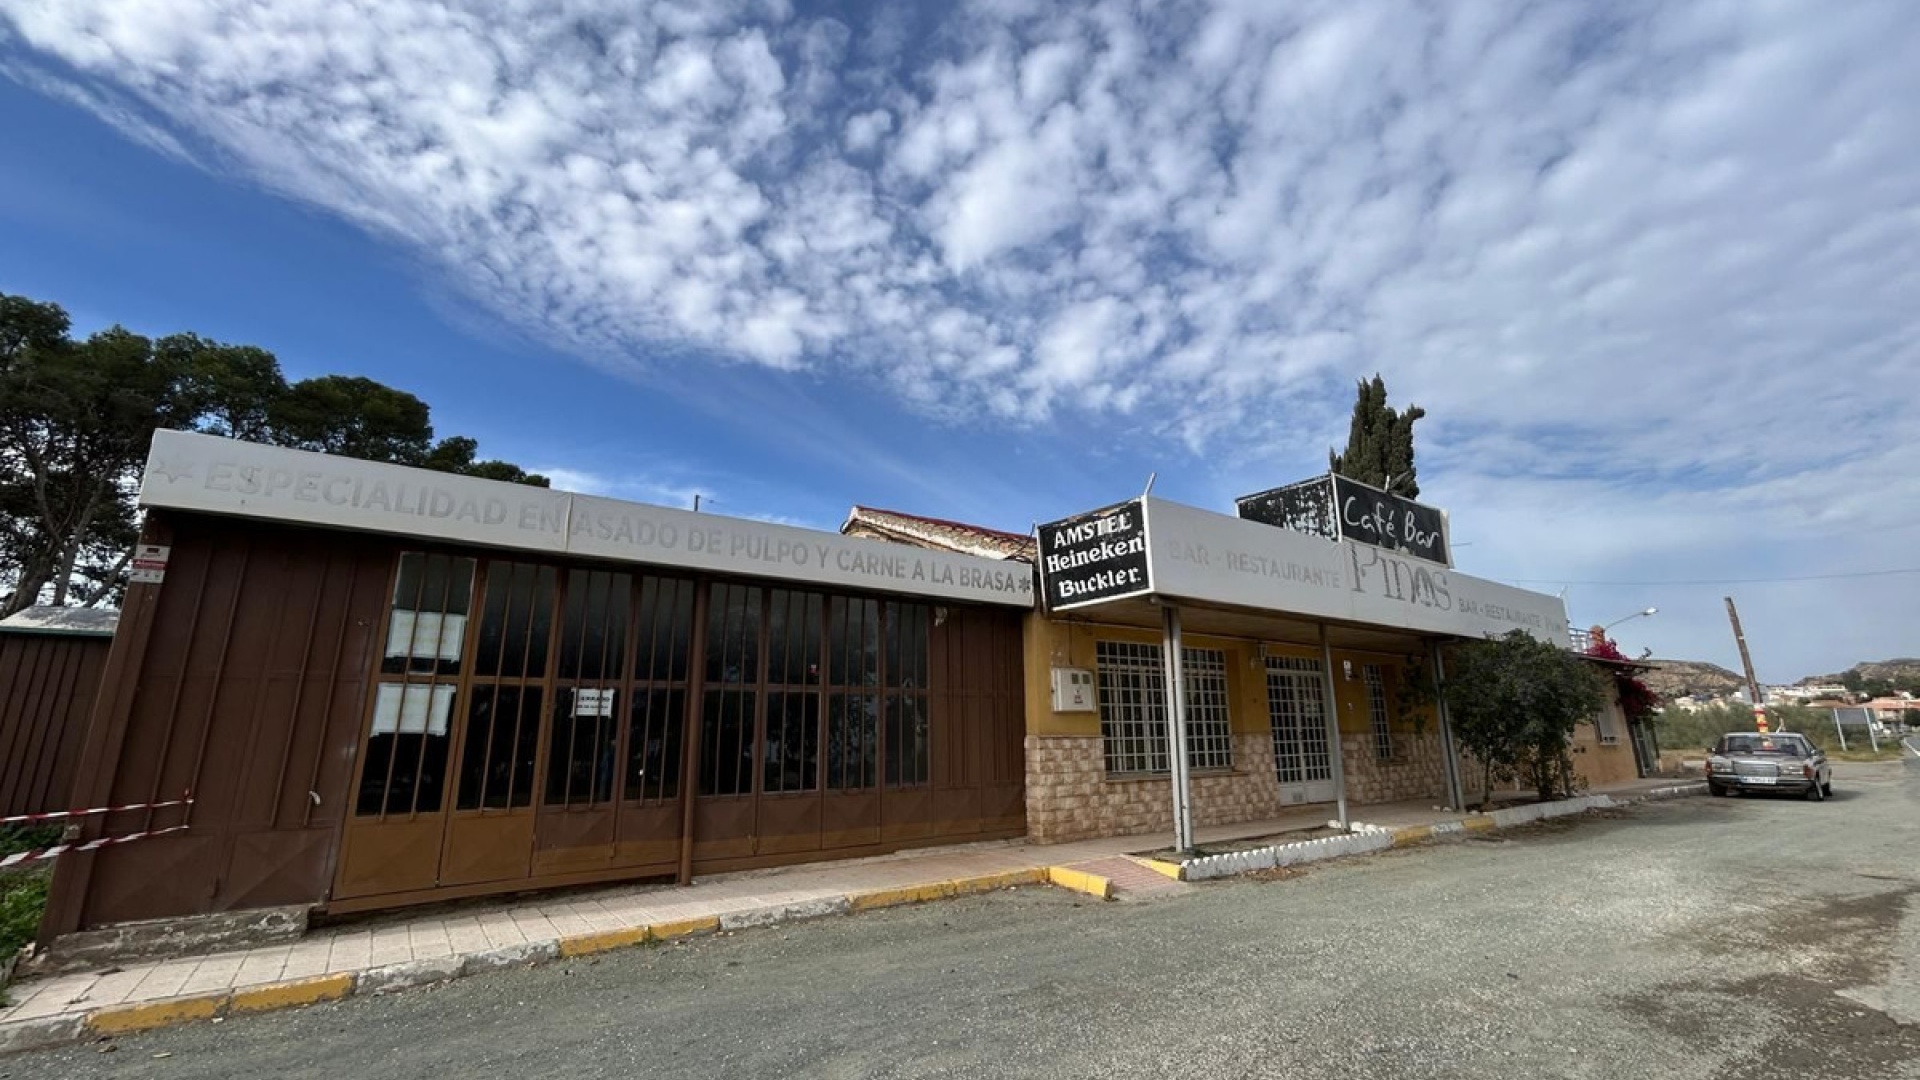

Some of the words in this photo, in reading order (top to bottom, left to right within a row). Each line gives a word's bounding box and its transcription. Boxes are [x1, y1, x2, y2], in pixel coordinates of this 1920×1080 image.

[205, 463, 506, 525] ESPECIALIDAD
[519, 505, 561, 533] EN
[572, 513, 678, 549] ASADO
[687, 526, 722, 555] DE
[731, 533, 809, 566] PULPO
[816, 544, 830, 568] Y
[836, 549, 905, 579] CARNE
[911, 560, 925, 581] A
[931, 563, 955, 584] LA
[959, 566, 1016, 594] BRASA
[1344, 497, 1396, 538] Café
[1406, 511, 1441, 549] Bar
[1170, 539, 1209, 566] BAR
[1228, 549, 1341, 588] RESTAURANTE
